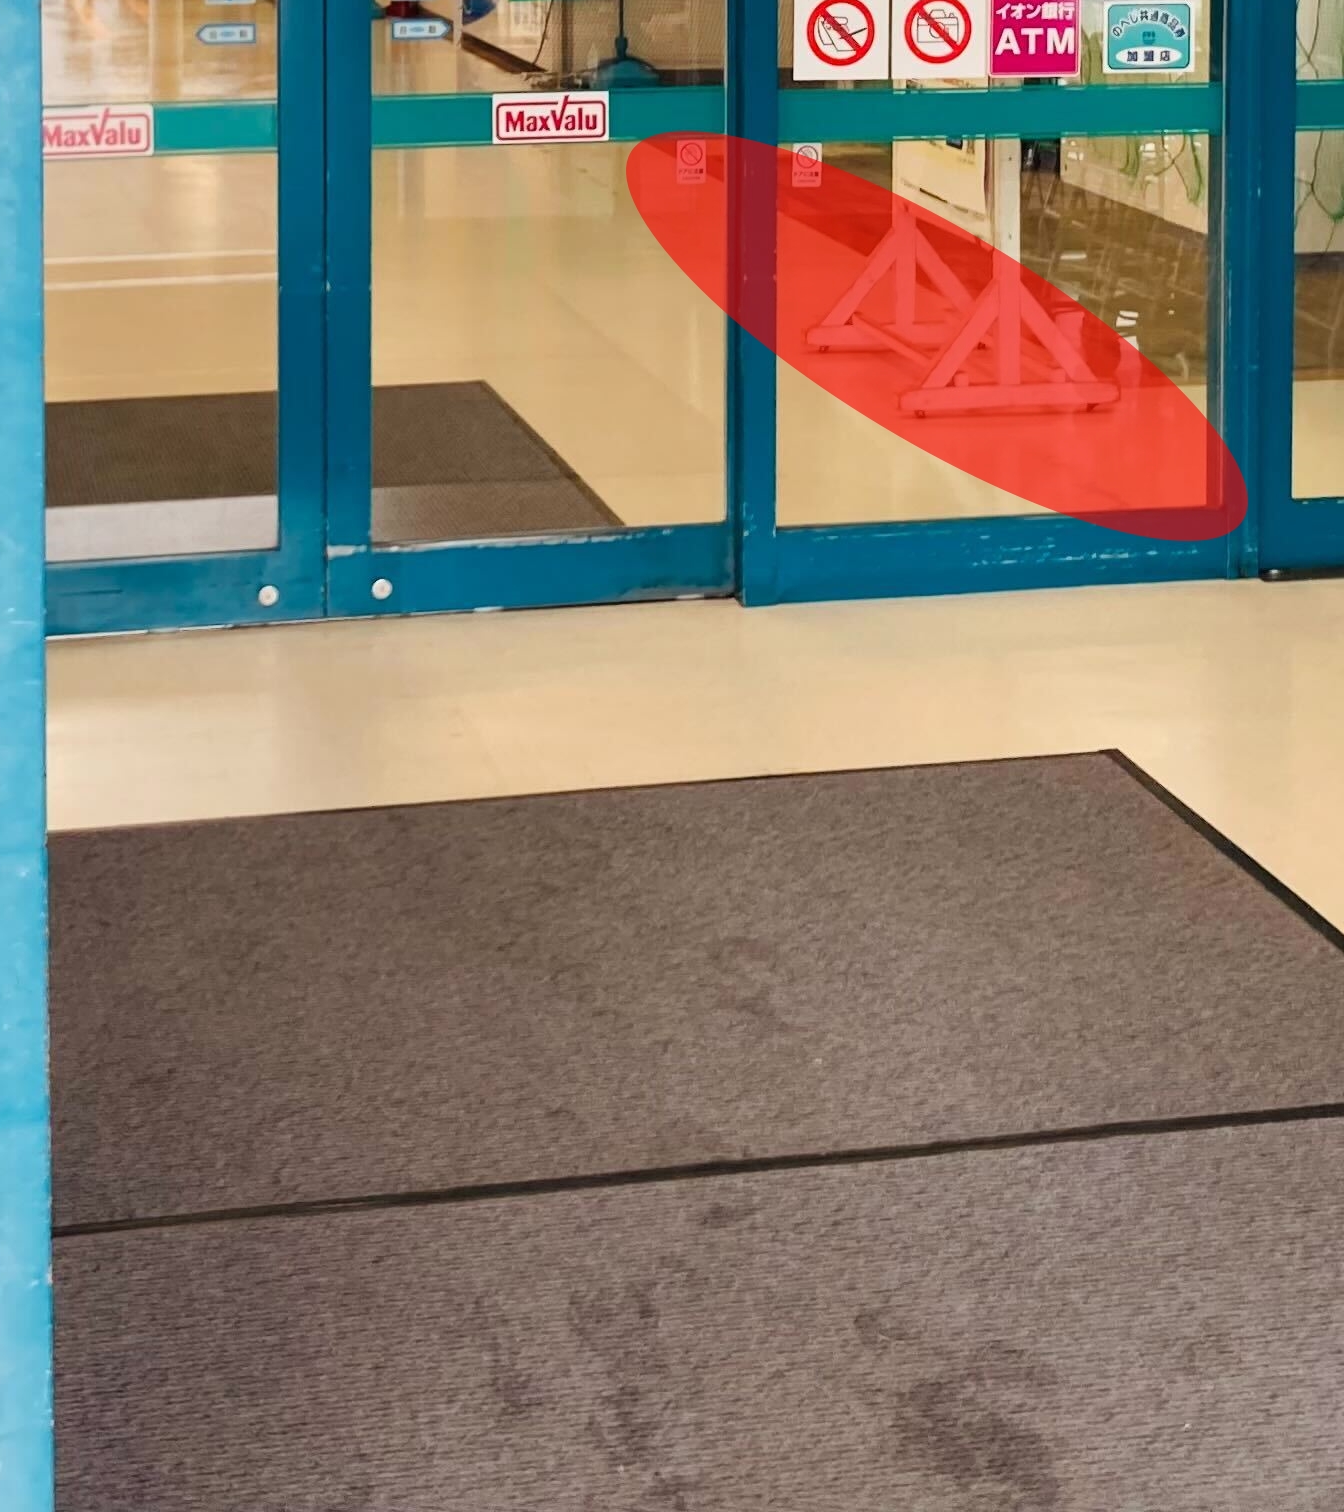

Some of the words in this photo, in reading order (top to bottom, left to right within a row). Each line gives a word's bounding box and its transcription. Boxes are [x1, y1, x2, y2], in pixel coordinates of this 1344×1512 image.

[995, 2, 1075, 20] イオン銀行
[995, 28, 1075, 55] ATM
[505, 94, 598, 133] MaxValu
